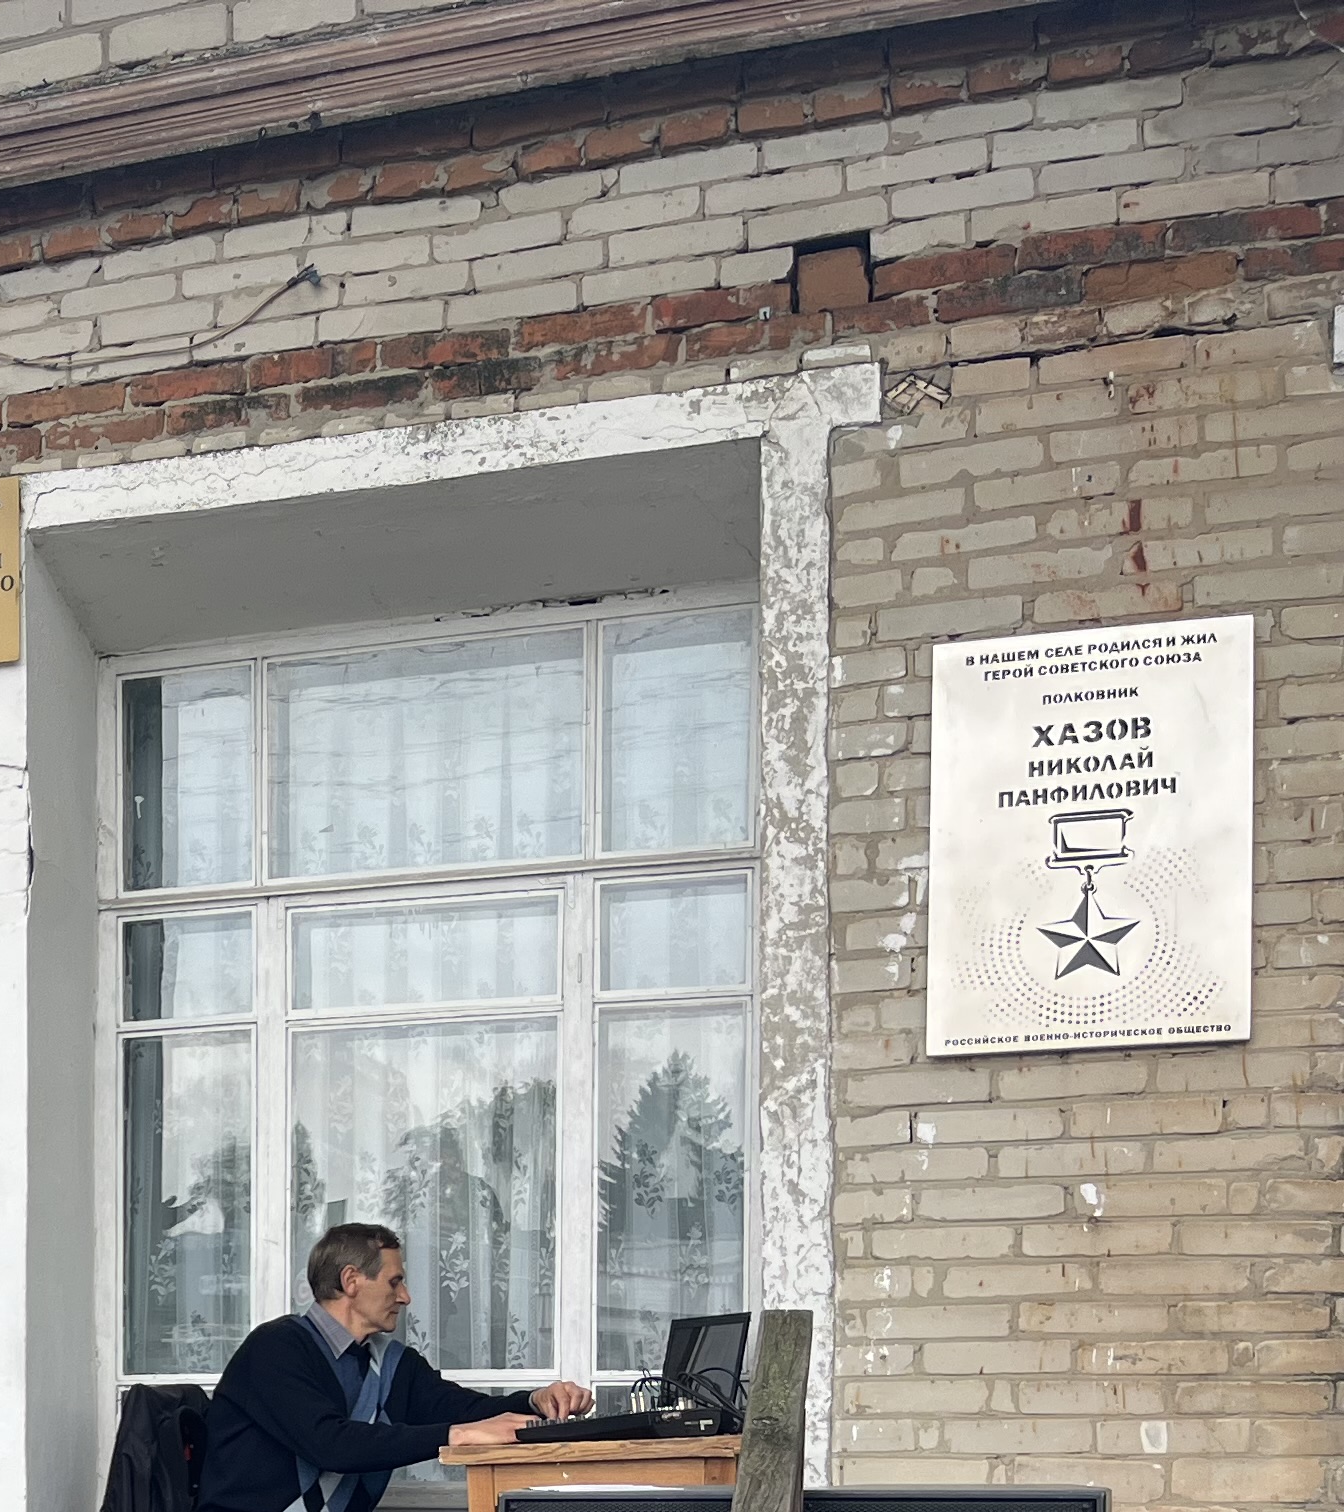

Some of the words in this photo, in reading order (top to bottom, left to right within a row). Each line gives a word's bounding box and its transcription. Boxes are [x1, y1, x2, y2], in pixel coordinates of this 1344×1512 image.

[966, 655, 976, 667] В
[979, 648, 1040, 666] НАШЕМ
[1044, 643, 1083, 659] СЕЛЕ
[1087, 637, 1163, 655] РОДИЛСЯ
[1166, 637, 1176, 648] И
[1181, 632, 1218, 646] ЖИЛ
[984, 662, 1034, 682] ГЕРОЙ
[1038, 657, 1139, 677] СОВЕТСКОГО
[1143, 651, 1202, 667] СОЮЗА
[1042, 686, 1139, 706] ПОЛКОВНИК
[1031, 715, 1152, 749] ХАЗОВ
[1027, 746, 1154, 779] НИКОЛАЙ
[997, 777, 1178, 809] ПАНФИЛОВИЧ
[944, 1035, 1019, 1047] РОССИЙСКОЕ
[1024, 1027, 1163, 1043] ВОЕННО-ИСТОРИЧЕСКОЕ
[1168, 1024, 1232, 1035] ОБЩЕСТВО
